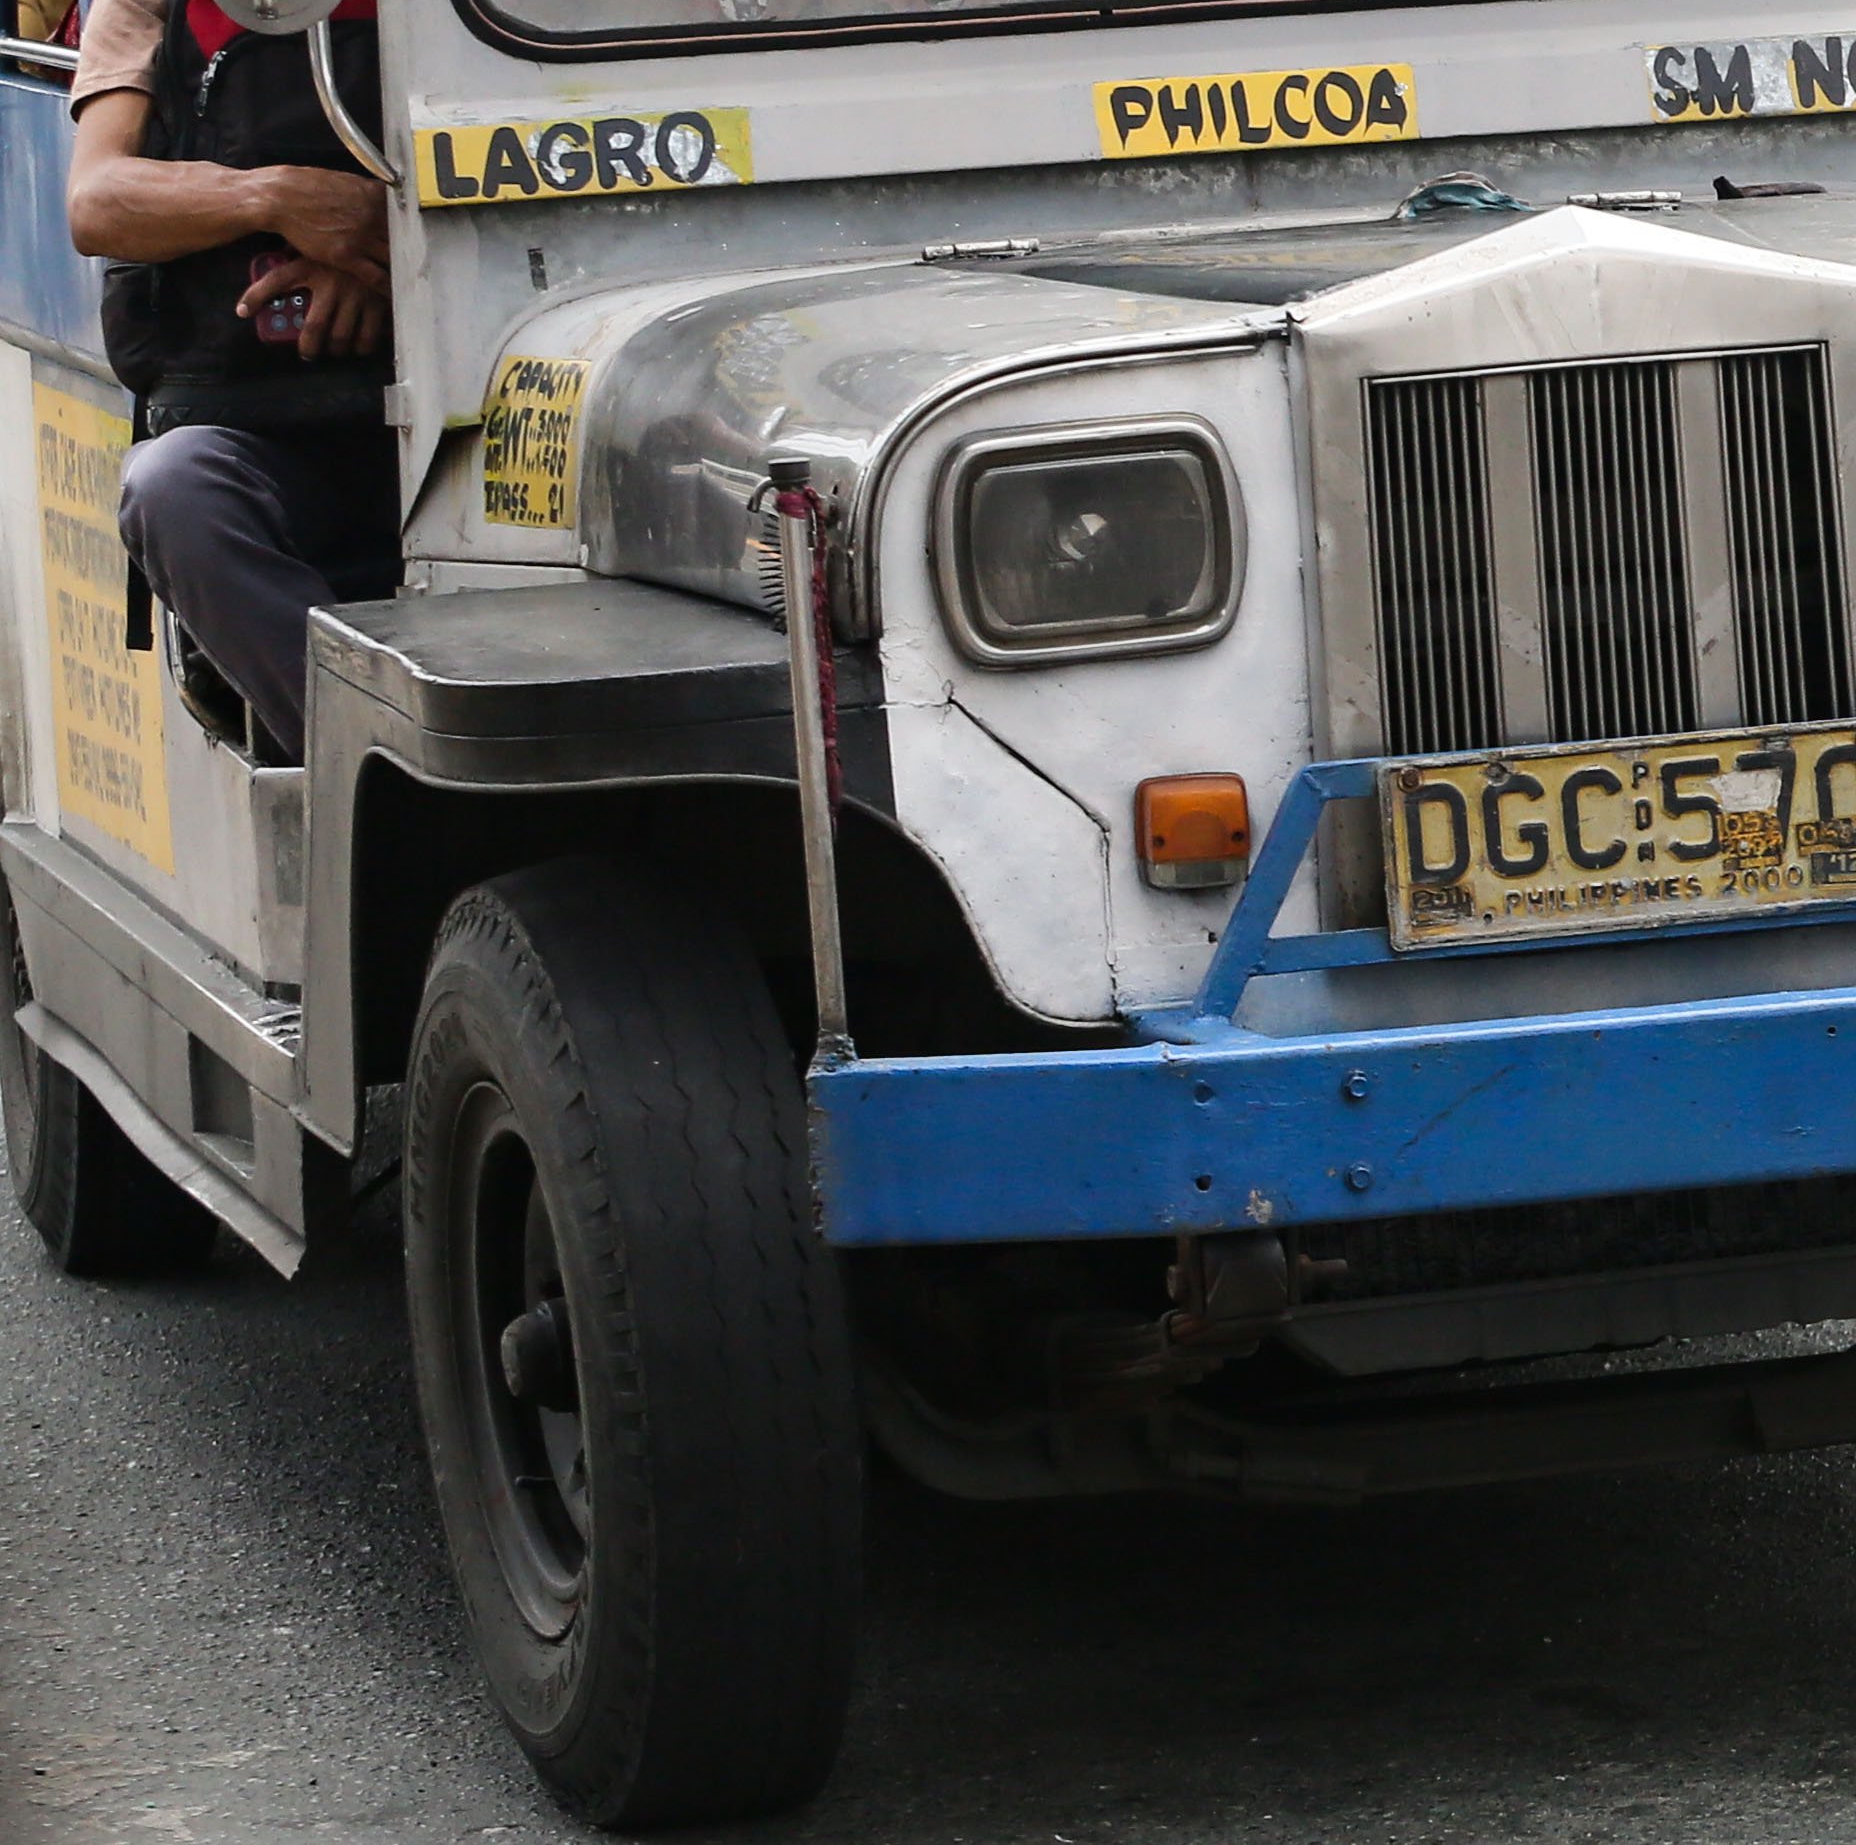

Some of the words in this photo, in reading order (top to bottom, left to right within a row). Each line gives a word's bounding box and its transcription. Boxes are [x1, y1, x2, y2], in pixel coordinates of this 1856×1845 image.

[1109, 67, 1409, 155] PHILCOA
[1651, 44, 1755, 116] SM
[432, 110, 717, 200] LAGRO
[500, 359, 587, 401] CAPACITY
[1719, 865, 1804, 895] 2000
